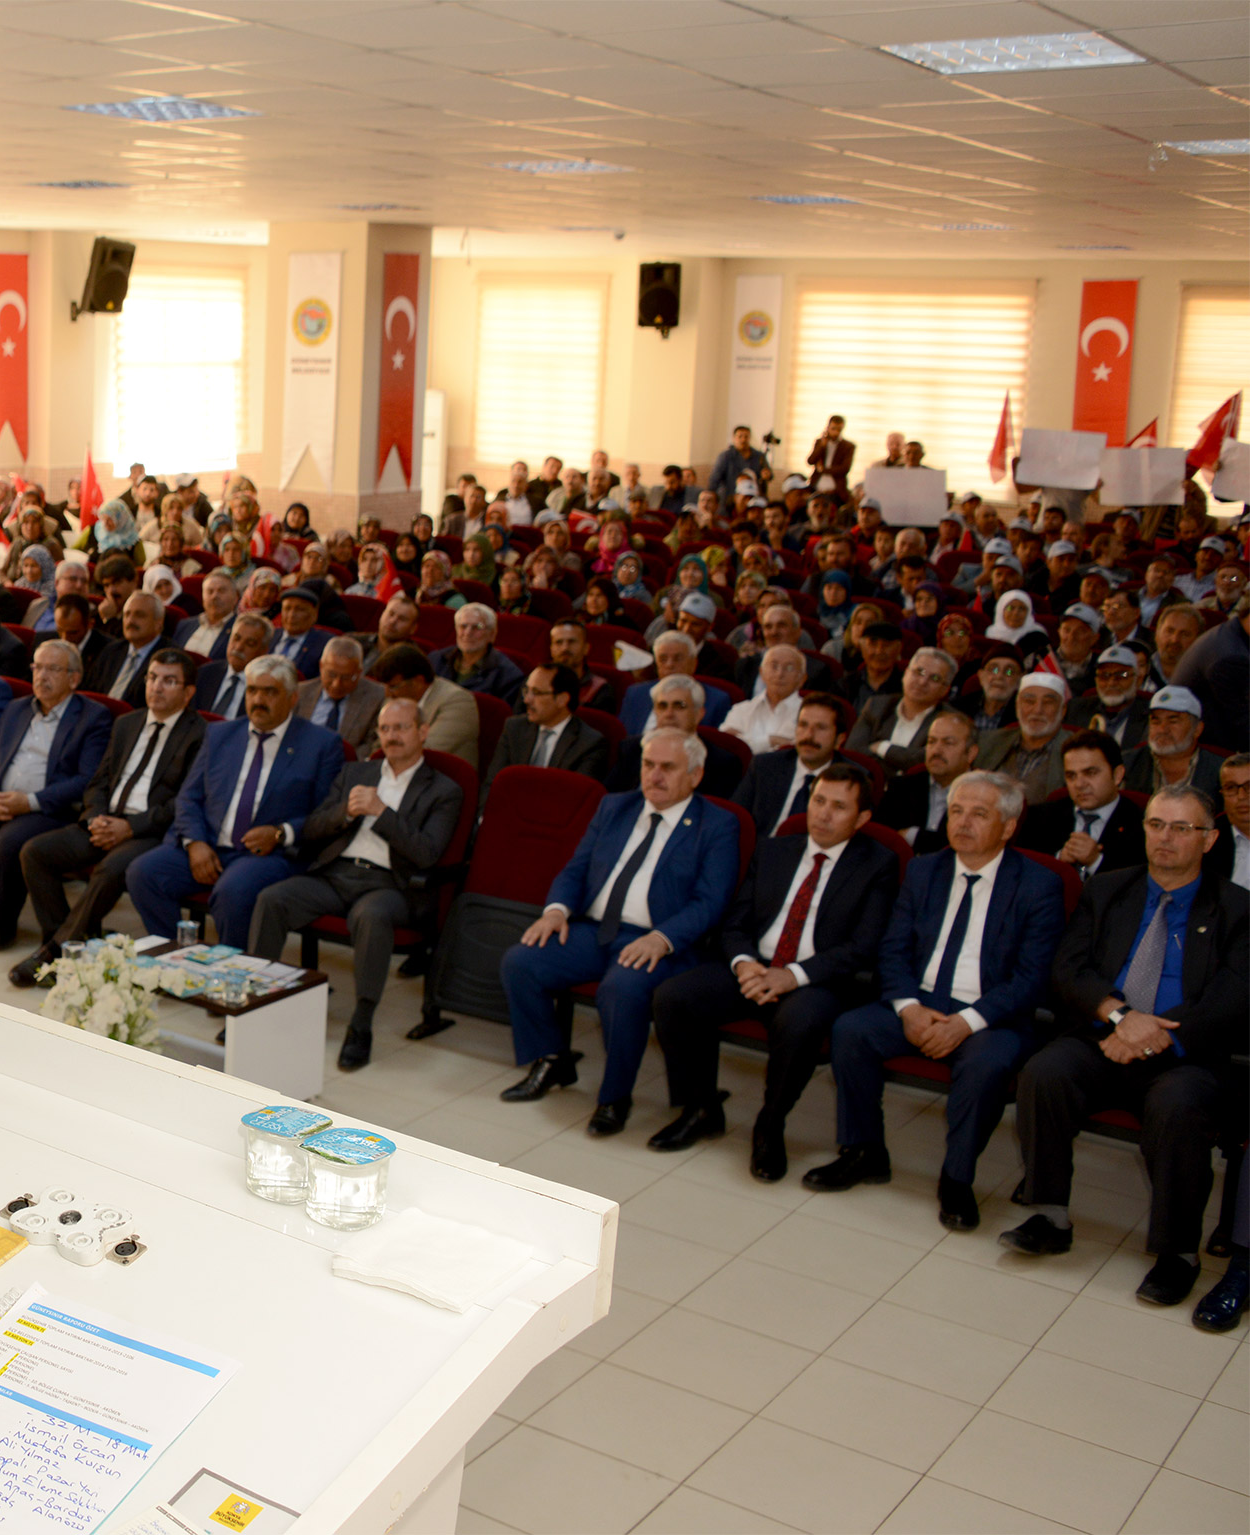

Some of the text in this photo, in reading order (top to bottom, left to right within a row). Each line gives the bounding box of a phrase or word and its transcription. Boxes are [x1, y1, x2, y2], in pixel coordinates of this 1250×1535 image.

[32, 1304, 100, 1333] GÜNEYSINIR RAPORU ÖZET
[41, 1415, 68, 1430] 32
[0, 1437, 17, 1450] Ali
